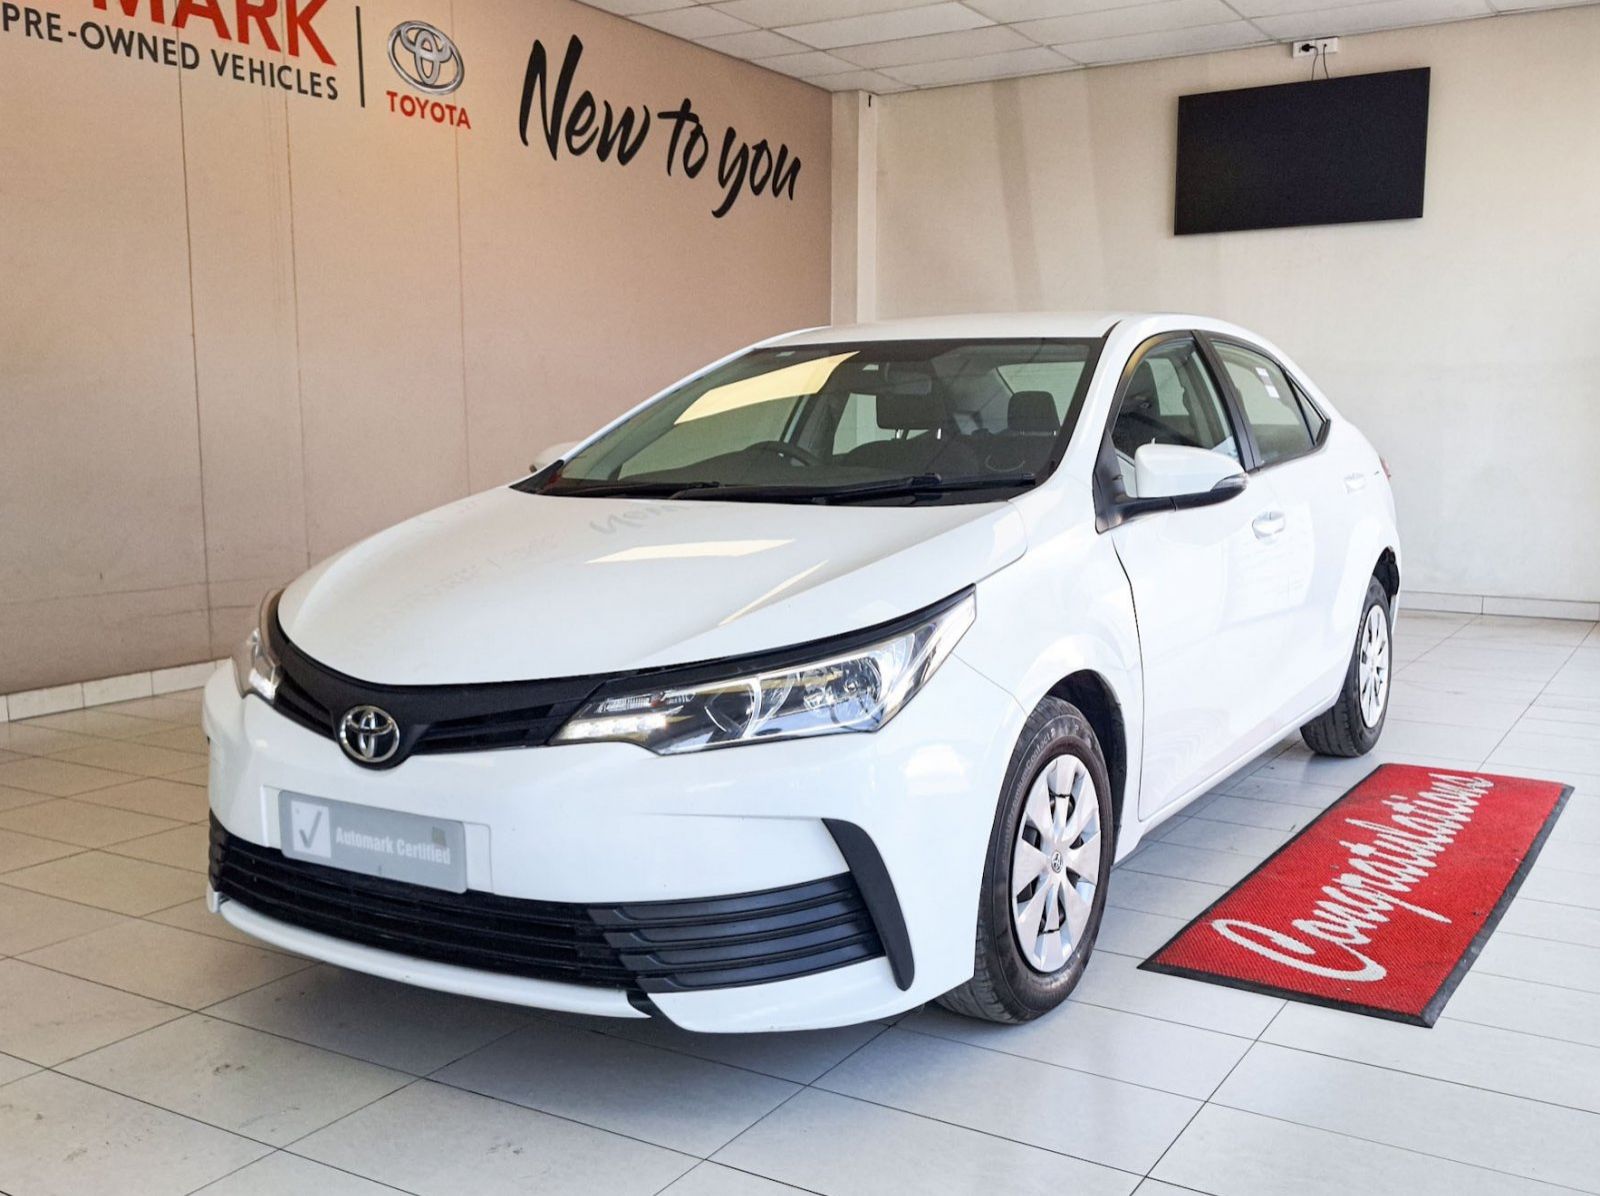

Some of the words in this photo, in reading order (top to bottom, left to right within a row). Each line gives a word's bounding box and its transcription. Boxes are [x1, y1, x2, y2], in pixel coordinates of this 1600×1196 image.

[2, 2, 200, 71] PRE-OWNED
[211, 48, 338, 100] VEHICLES
[93, 0, 337, 66] ARK
[386, 91, 471, 129] TOYOTA
[519, 34, 650, 166] New
[657, 97, 709, 179] to
[711, 126, 801, 218] you
[336, 826, 394, 854] Automark
[396, 838, 451, 865] Certified
[1211, 772, 1494, 982] Congratulations
